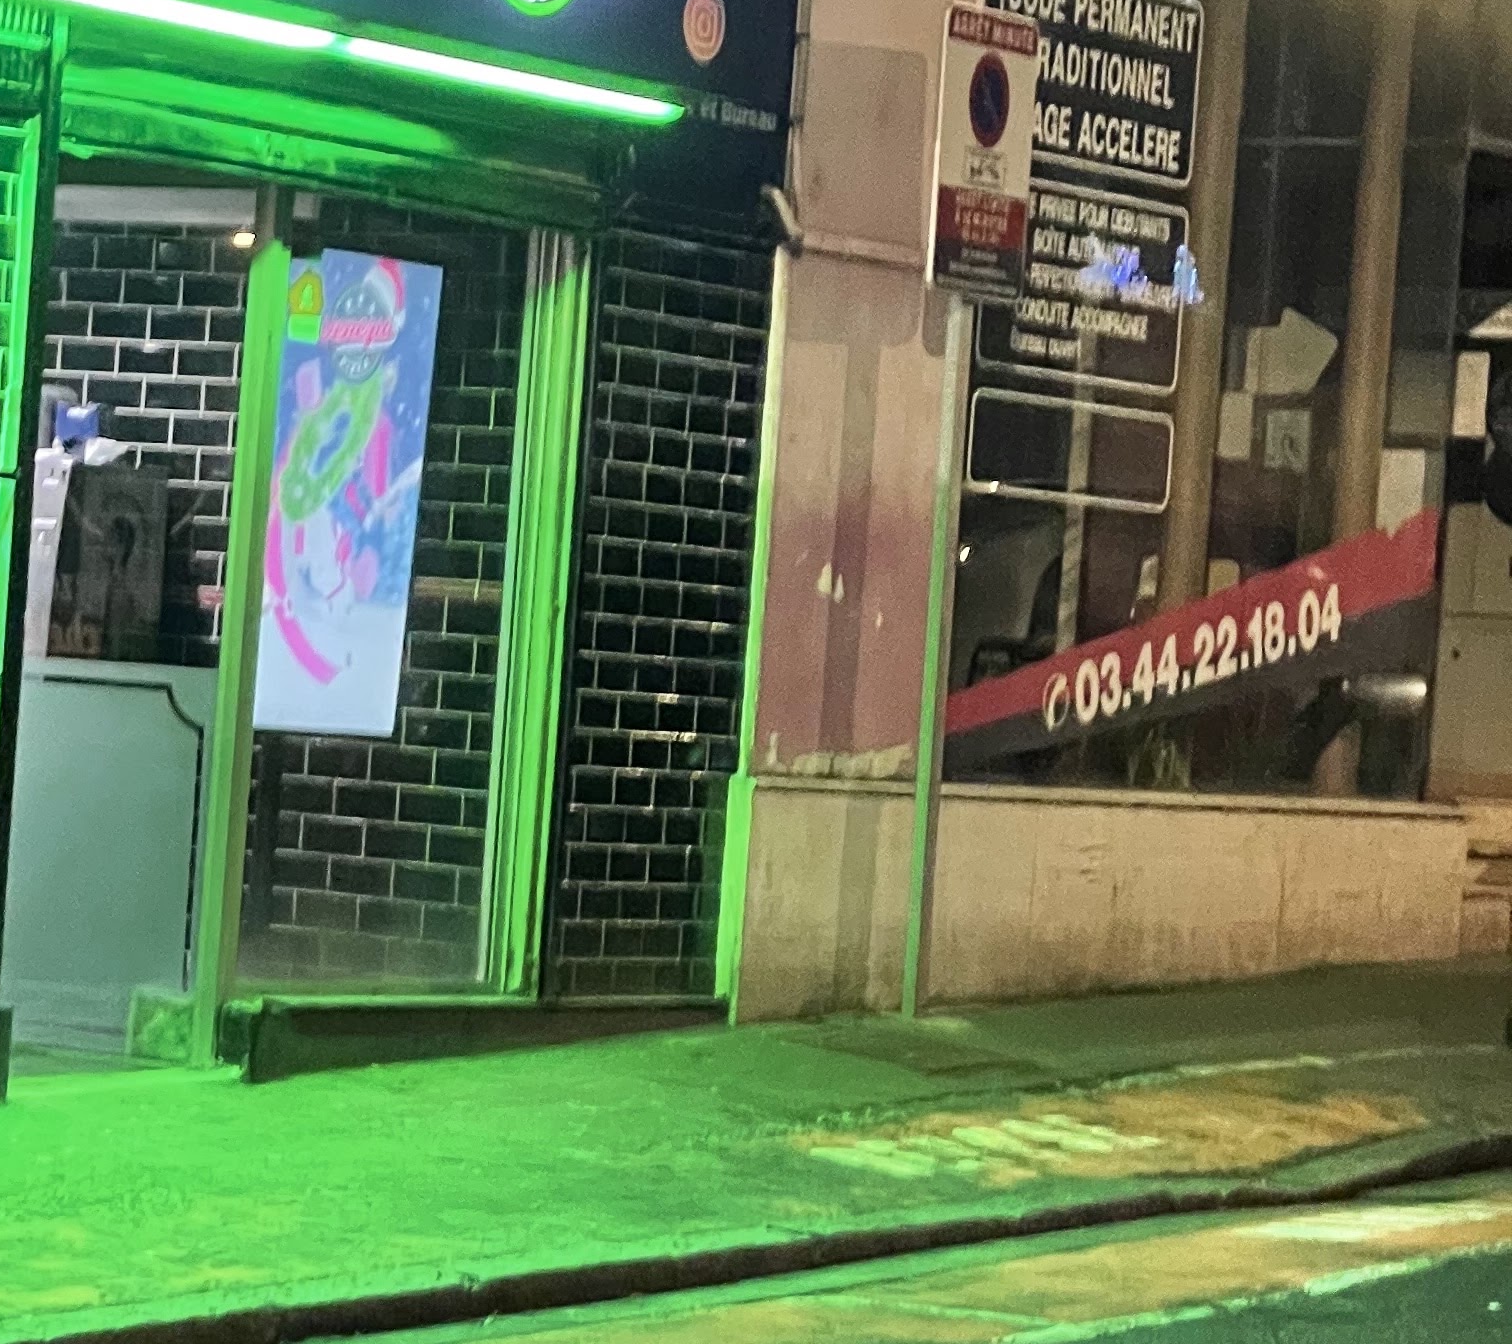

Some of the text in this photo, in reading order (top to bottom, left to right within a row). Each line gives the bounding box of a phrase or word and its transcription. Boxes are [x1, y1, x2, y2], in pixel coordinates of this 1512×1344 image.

[1037, 37, 1176, 110] RADITIONNEL
[1032, 101, 1182, 175] AGE ACCELERE
[1075, 584, 1341, 724] 03.44.22.18.04
